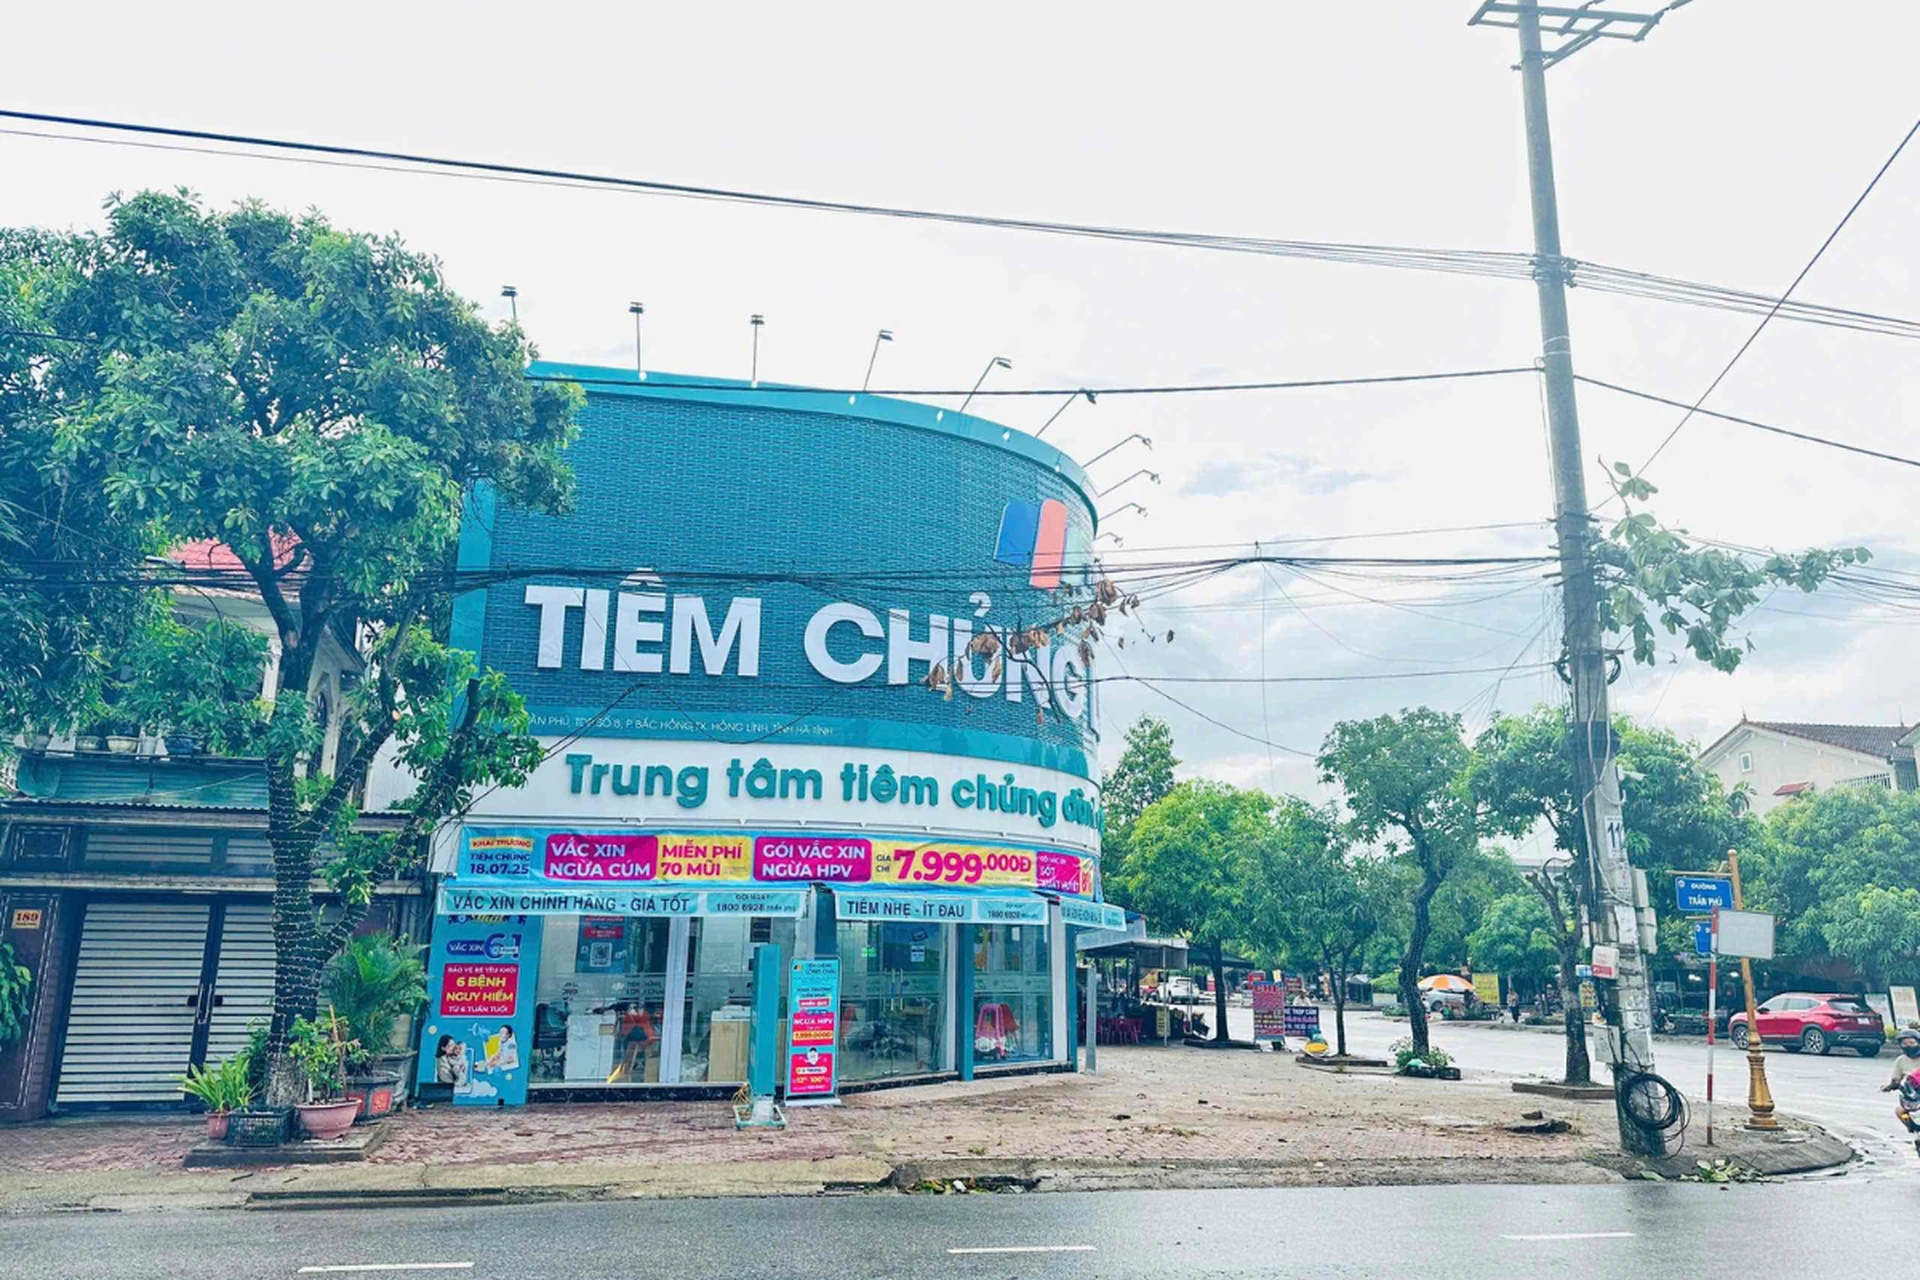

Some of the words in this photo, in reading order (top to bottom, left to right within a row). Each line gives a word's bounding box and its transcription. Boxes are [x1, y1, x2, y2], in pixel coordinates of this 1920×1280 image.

[525, 568, 761, 677] TIÊM
[804, 591, 1085, 719] CHỦNG
[565, 753, 708, 809] Trung
[727, 757, 822, 800] tâm
[840, 761, 938, 807] tiêm
[952, 773, 1056, 829] chủng
[551, 836, 589, 857] VẮC
[593, 843, 626, 857] XIN
[662, 839, 707, 858] MIỄN
[712, 842, 743, 859] PHÍ
[762, 840, 793, 858] GÓI
[797, 840, 834, 859] VẮC
[837, 846, 866, 859] XIN
[471, 851, 493, 861] TIÊM
[470, 863, 529, 875] 18.07.25
[549, 859, 604, 877] NGỪA
[608, 859, 651, 877] CÚM
[661, 862, 682, 876] 70
[686, 859, 720, 876] MŨI
[762, 860, 813, 877] NGỪA
[817, 864, 852, 878] HPV
[489, 896, 515, 910] XIN
[520, 893, 568, 910] CHÍNH
[573, 893, 616, 911] HÃNG
[630, 892, 656, 912] GIÁ
[660, 891, 690, 912] TỐT
[717, 903, 739, 912] 1800
[741, 903, 765, 912] 6928
[847, 896, 879, 915] TIÊM
[884, 902, 911, 918] NHẸ
[923, 900, 935, 917] ÍT
[938, 904, 965, 918] ĐAU
[1688, 894, 1707, 906] TRẦN
[17, 912, 39, 921] 189
[469, 943, 483, 952] XIN
[456, 977, 466, 988] 6
[468, 974, 506, 989] BỆNH
[446, 992, 481, 1001] NGUY
